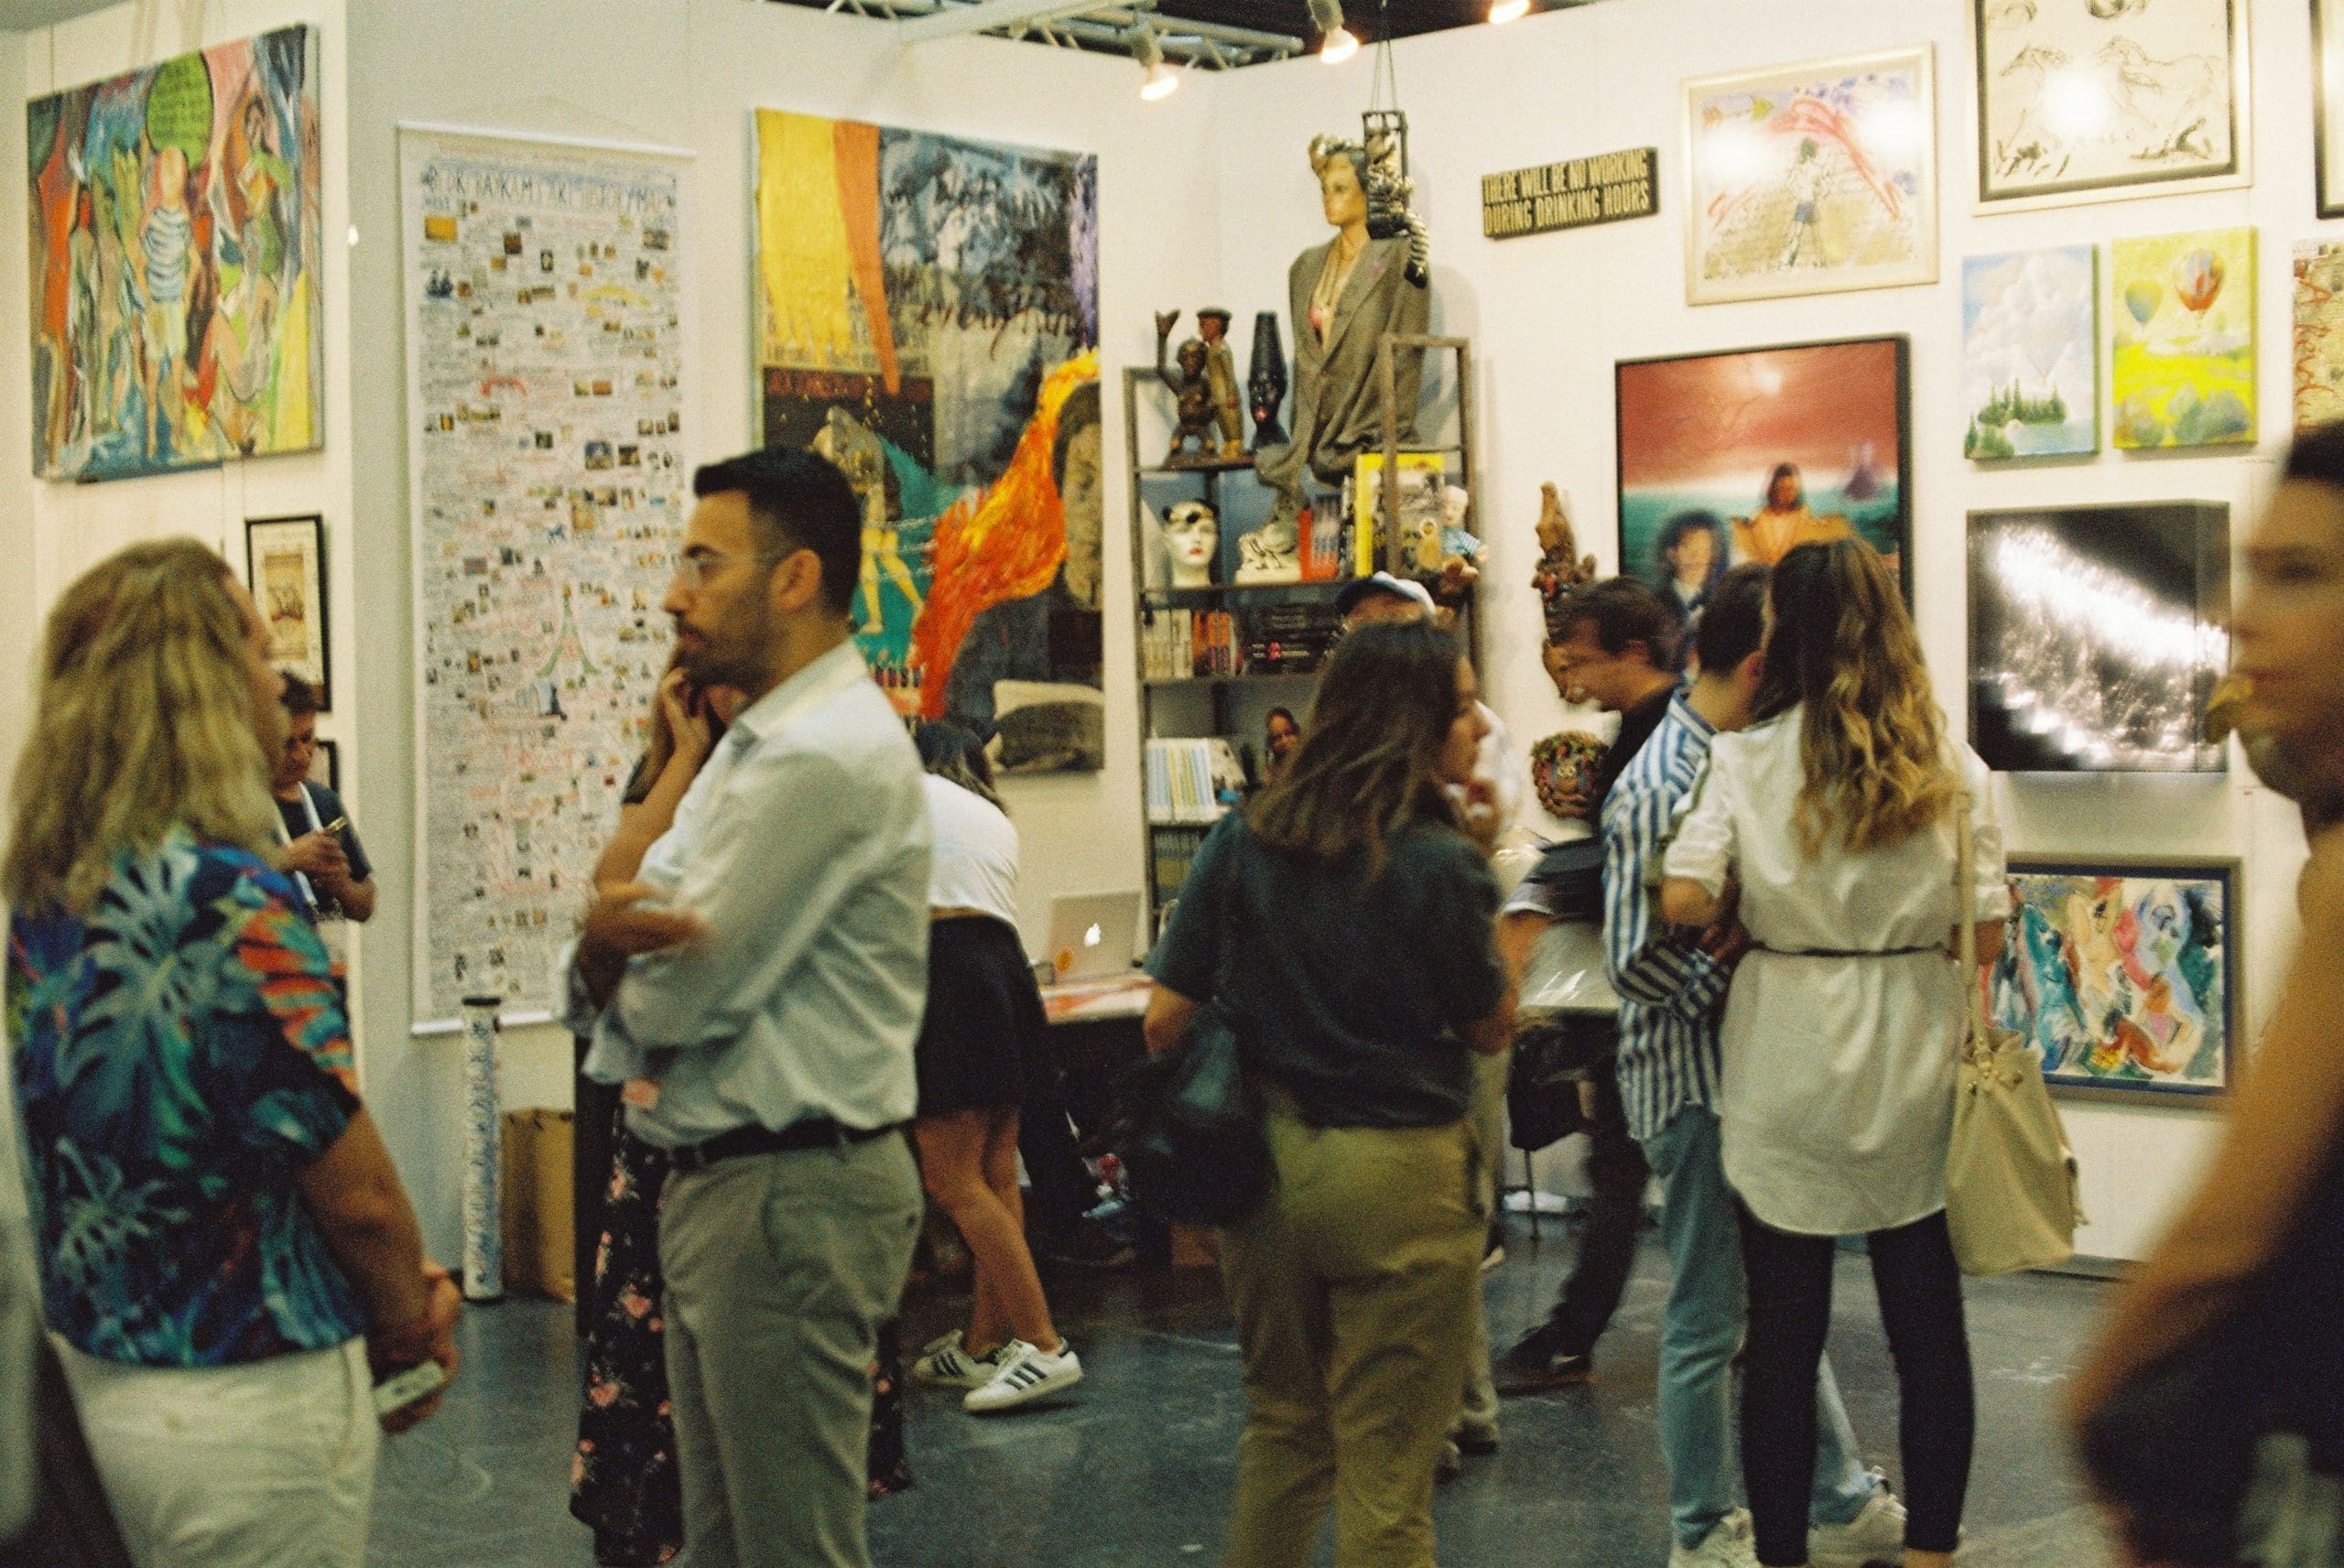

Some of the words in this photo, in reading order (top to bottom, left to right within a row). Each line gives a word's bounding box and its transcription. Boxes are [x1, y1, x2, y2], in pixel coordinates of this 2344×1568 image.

[1520, 166, 1548, 198] WILL
[1550, 163, 1567, 192] BE
[1484, 198, 1533, 234] DURING
[1535, 187, 1600, 226] DRINKING
[1602, 178, 1649, 216] HOURS
